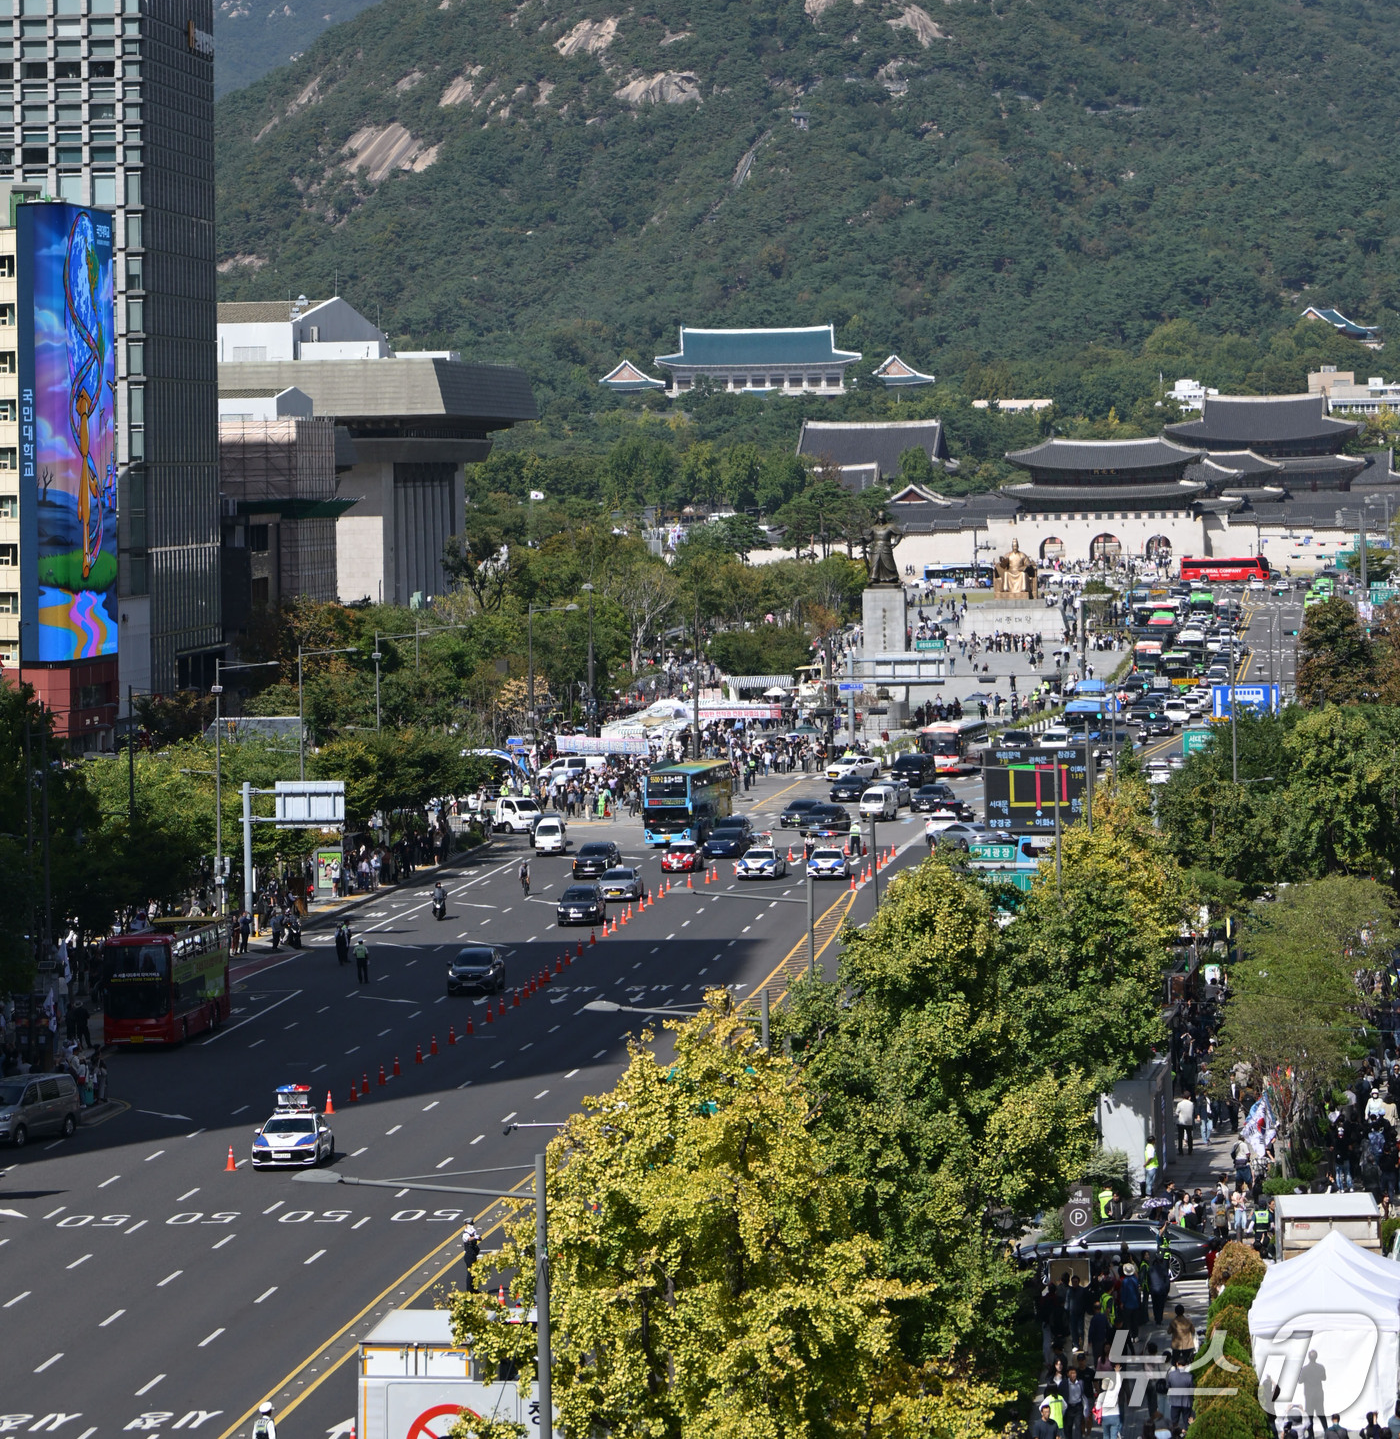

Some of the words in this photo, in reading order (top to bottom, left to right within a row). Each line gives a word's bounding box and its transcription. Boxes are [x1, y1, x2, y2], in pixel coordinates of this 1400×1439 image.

[22, 388, 34, 477] 국민대학교
[995, 615, 1032, 624] 세종대왕
[56, 1214, 132, 1227] 50
[165, 1212, 242, 1225] 50
[278, 1210, 353, 1223] 50
[390, 1208, 464, 1222] 50
[1075, 1212, 1083, 1224] P
[123, 1410, 224, 1430] 시청
